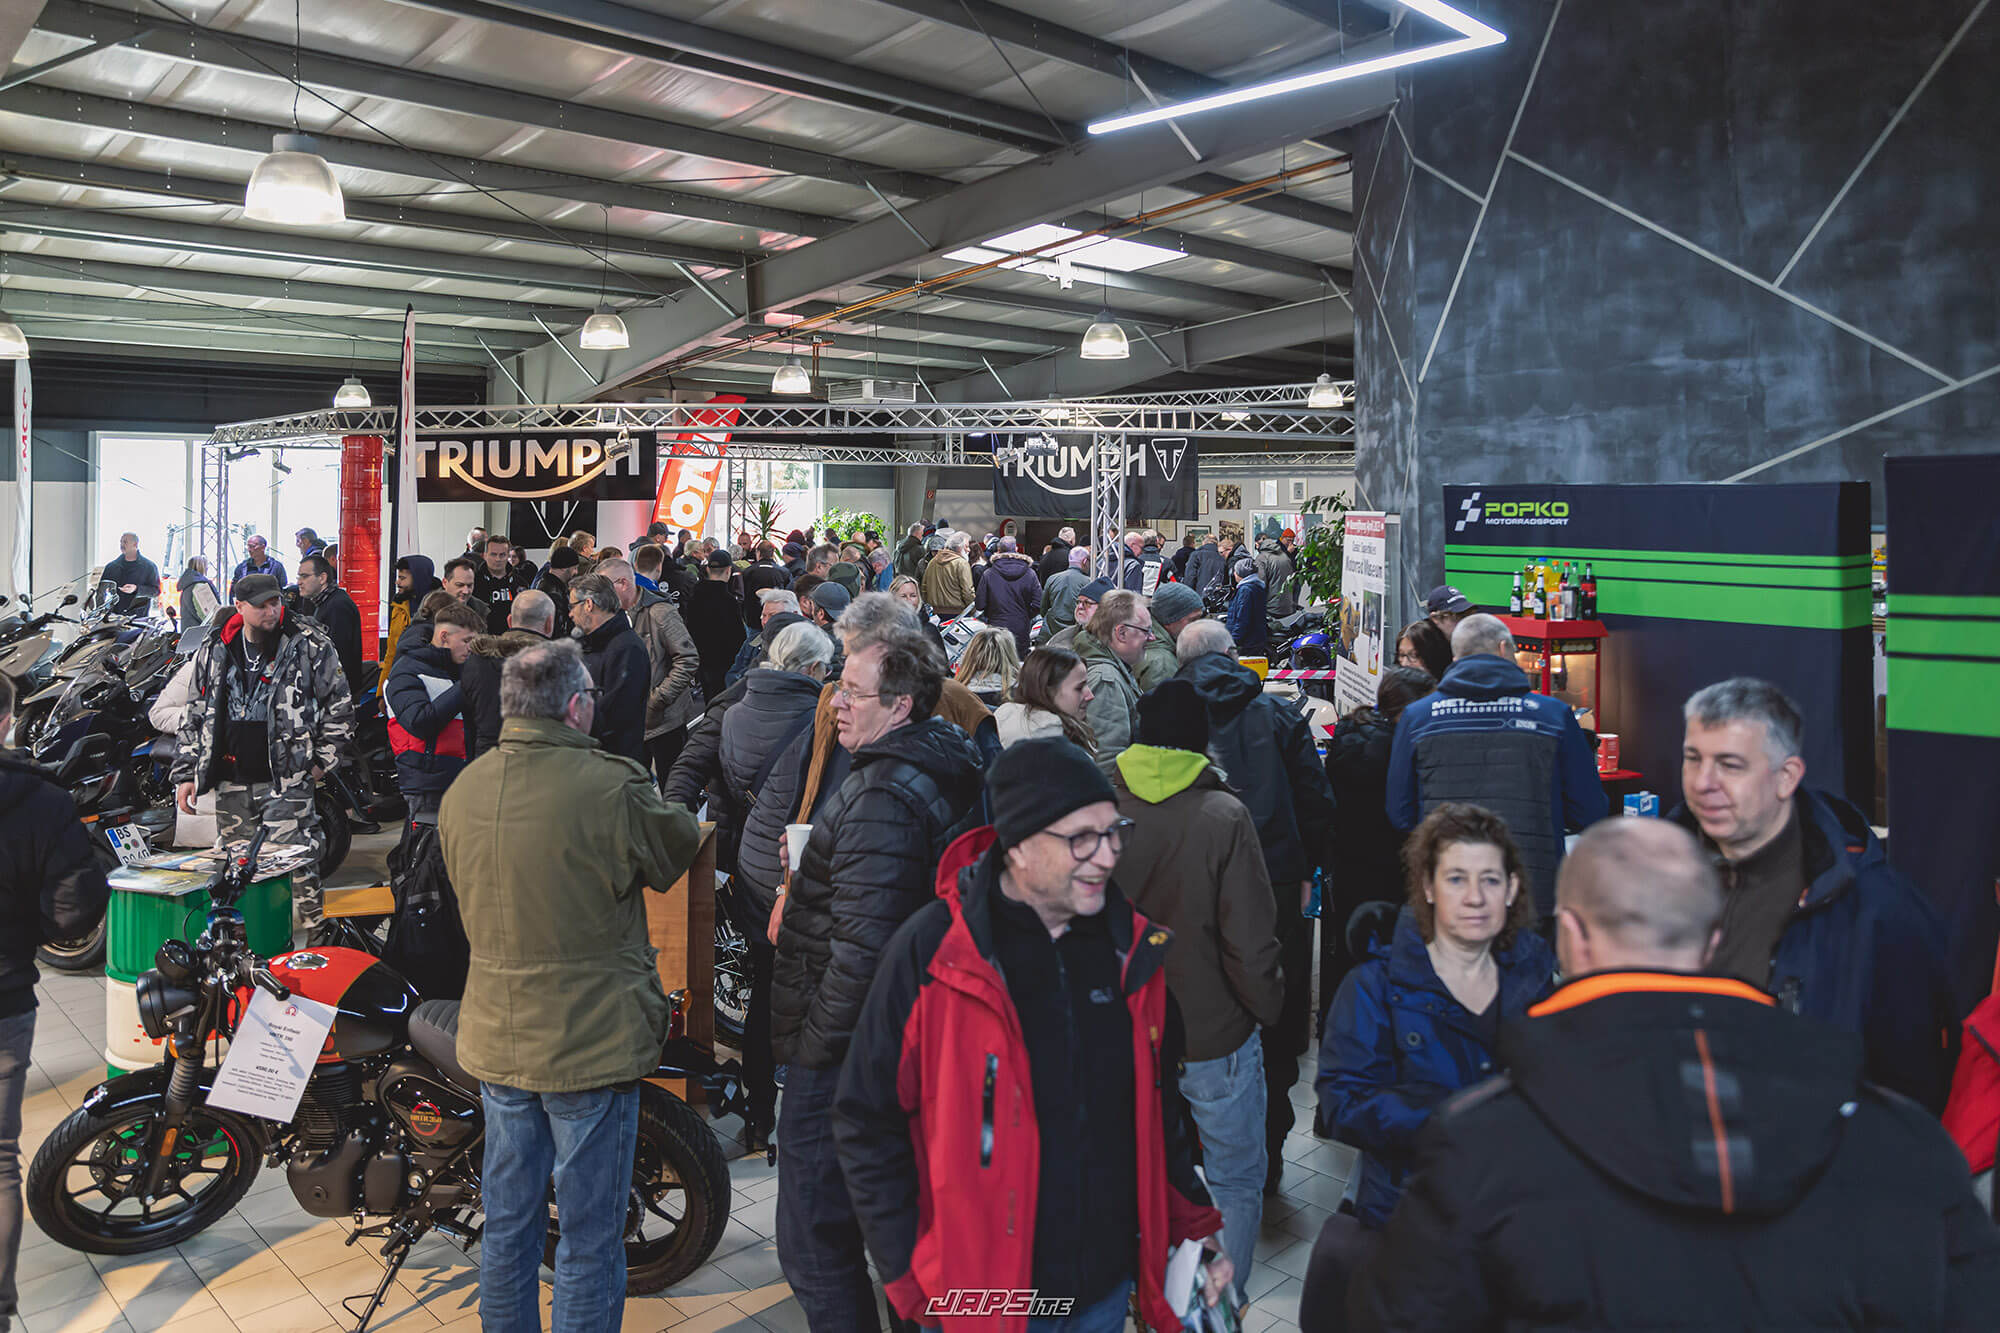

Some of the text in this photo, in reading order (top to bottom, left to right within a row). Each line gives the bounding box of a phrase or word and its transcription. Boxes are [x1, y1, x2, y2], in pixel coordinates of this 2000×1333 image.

[416, 439, 640, 497] TRIUMPH
[1485, 502, 1569, 517] POPKO
[1485, 518, 1569, 526] MOTORRADSPORT
[116, 826, 131, 839] BS
